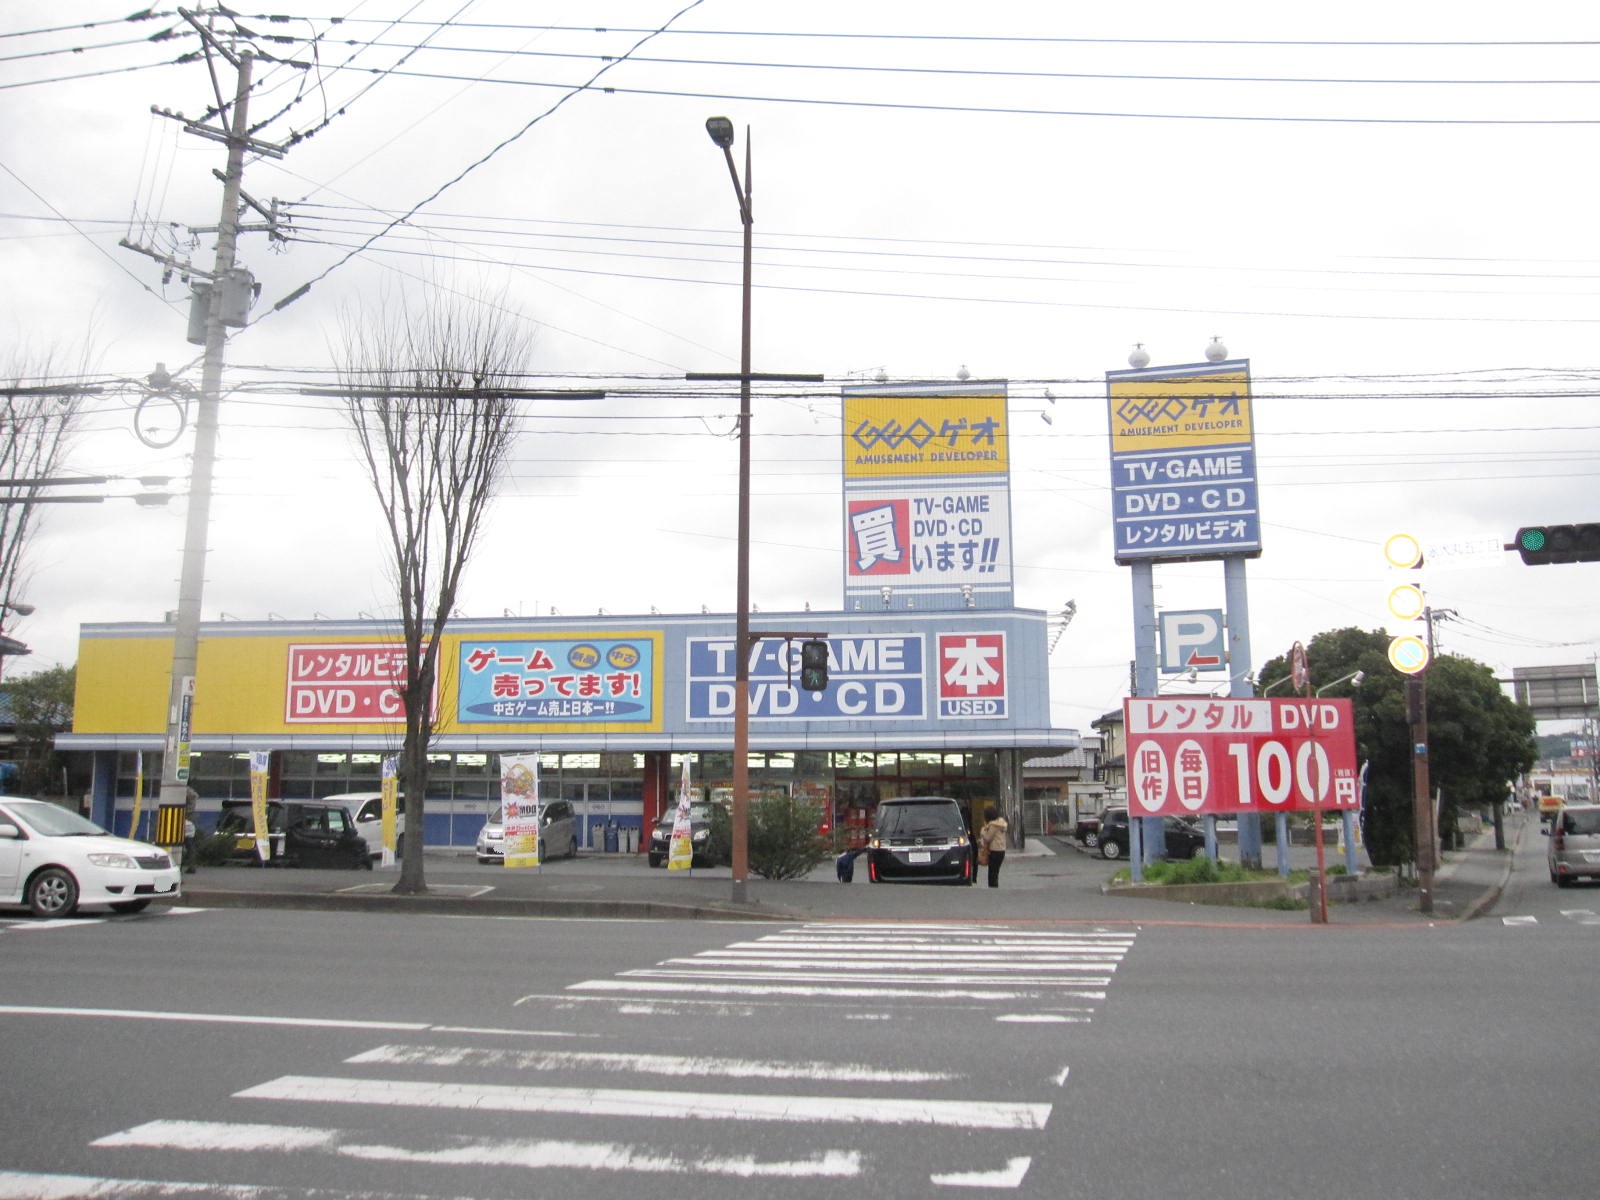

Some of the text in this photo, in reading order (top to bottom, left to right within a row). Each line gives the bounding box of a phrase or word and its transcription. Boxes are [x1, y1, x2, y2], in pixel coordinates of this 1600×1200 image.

[1120, 419, 1243, 436] AMUSEMENT DEVELOPER
[855, 450, 998, 465] AMUSEMENT DEVELOPER
[1123, 455, 1243, 481] TV-GAME
[913, 495, 990, 515] TV-GAME
[1126, 520, 1247, 544] レンタルビデオ
[1164, 613, 1218, 668] P
[467, 649, 554, 672] ゲーム
[944, 638, 1000, 694] 本
[947, 700, 998, 715] USED
[1147, 702, 1339, 730] レンタル DVD
[1141, 749, 1163, 801] 旧作
[1180, 748, 1203, 800] 毎日
